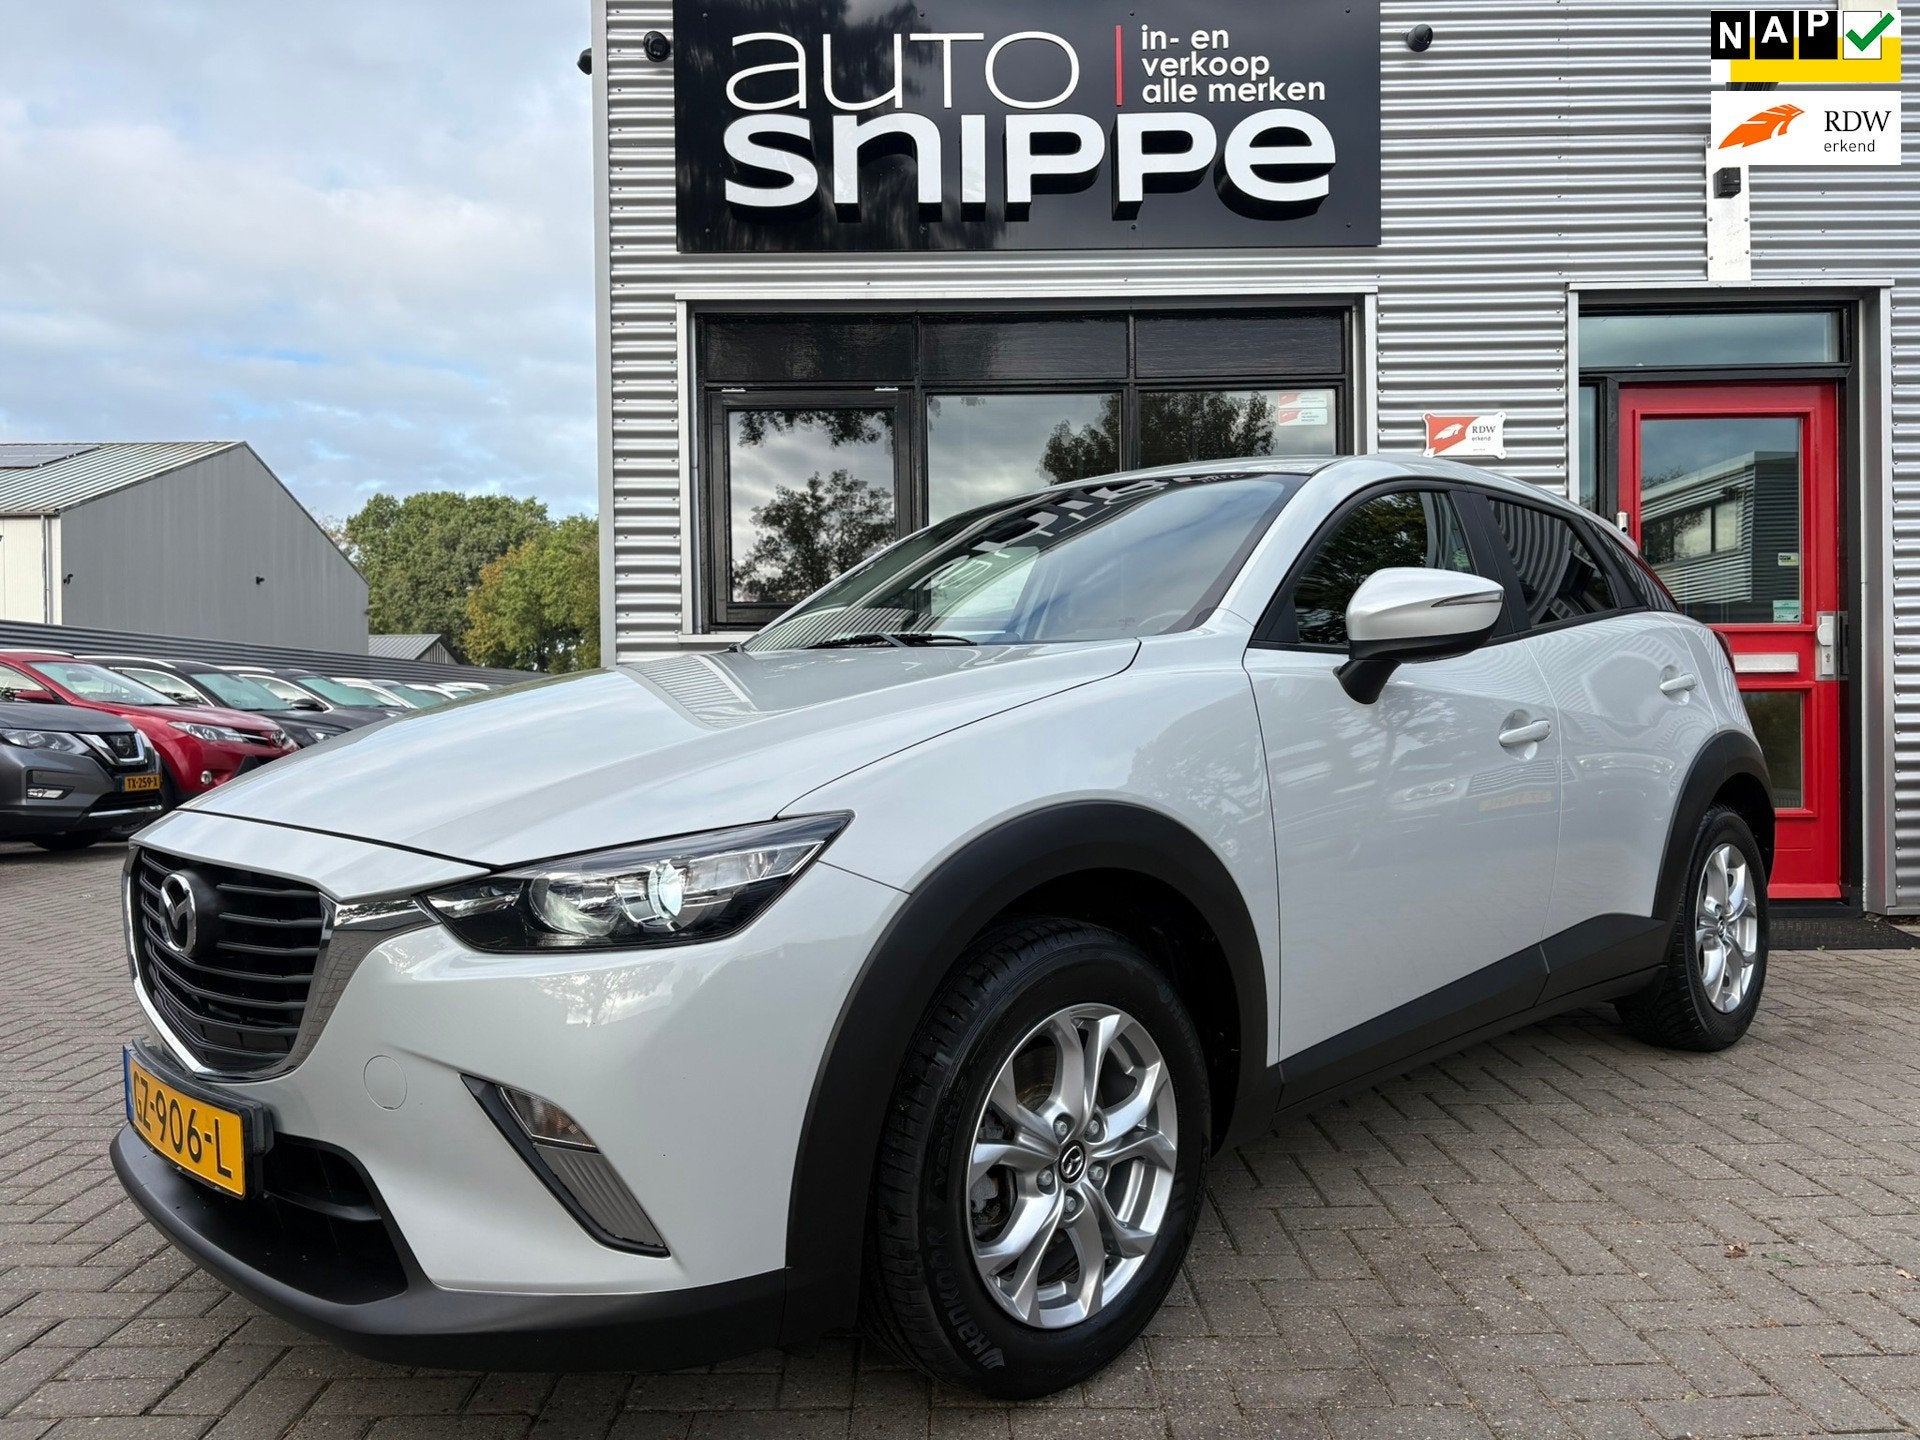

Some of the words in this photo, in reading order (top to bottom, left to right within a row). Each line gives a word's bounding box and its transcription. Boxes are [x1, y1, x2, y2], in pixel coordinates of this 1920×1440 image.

[1141, 24, 1180, 50] in-
[1191, 29, 1229, 50] en
[1141, 51, 1270, 82] verkoop
[1142, 77, 1198, 104] alle
[1208, 76, 1326, 103] merken
[1471, 425, 1496, 434] RDW
[127, 776, 159, 789] TX-259-X
[133, 1070, 233, 1180] GZ-906-L
